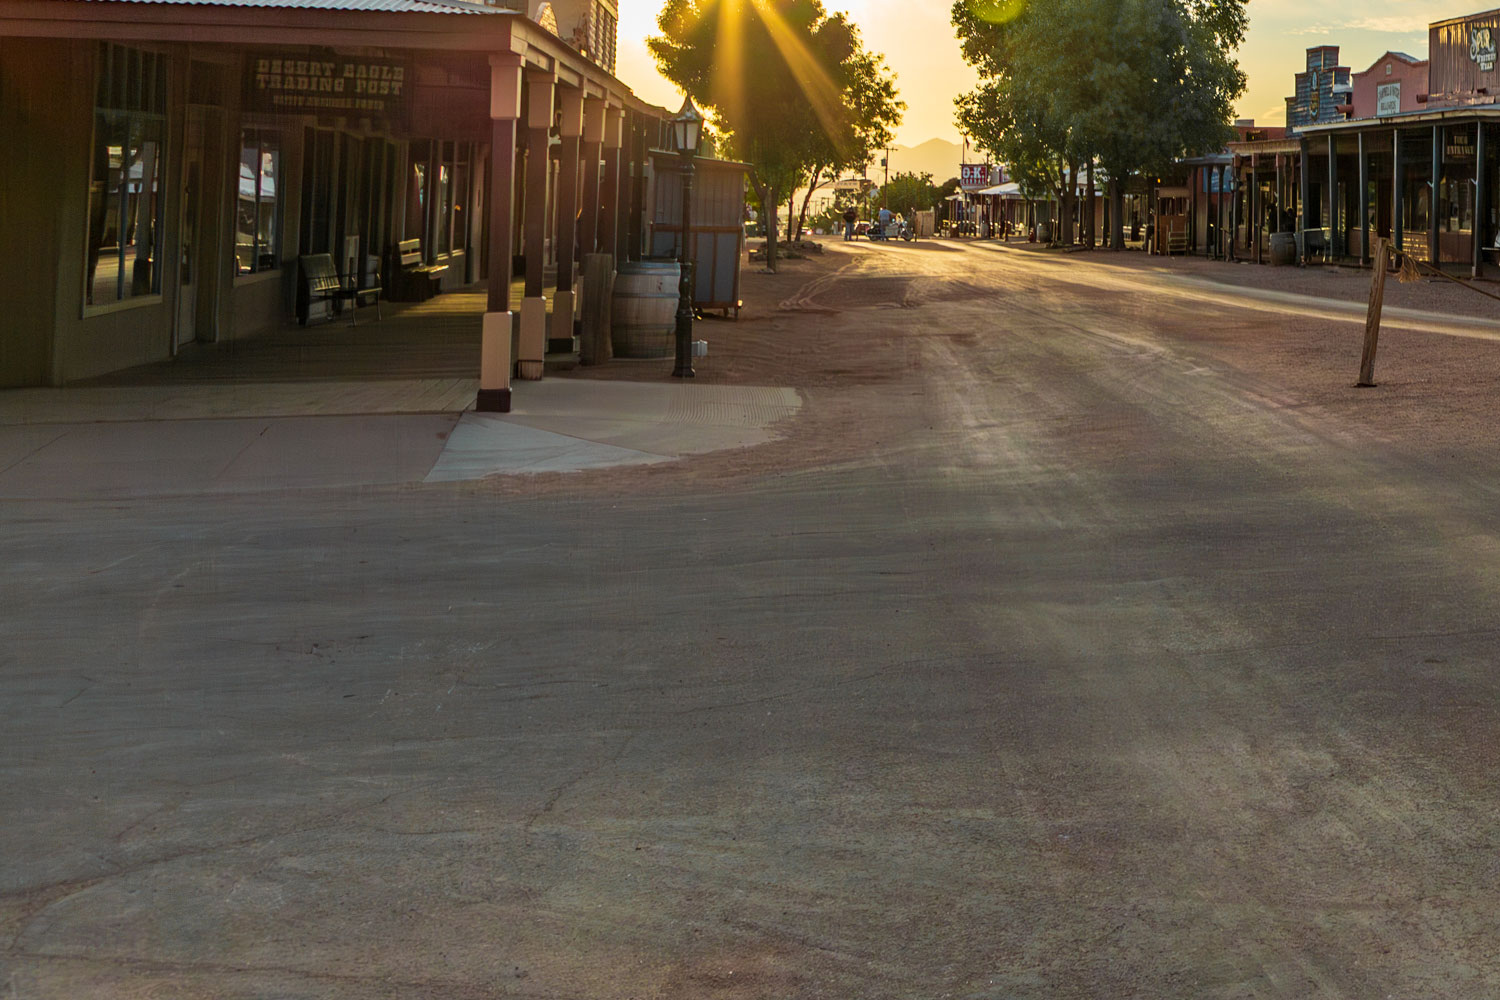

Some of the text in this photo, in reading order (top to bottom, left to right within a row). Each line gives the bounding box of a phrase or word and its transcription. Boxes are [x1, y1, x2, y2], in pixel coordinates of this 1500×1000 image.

[257, 59, 404, 81] DESERT EAGLE
[256, 74, 403, 96] TRADING POST
[963, 167, 985, 179] O.K.
